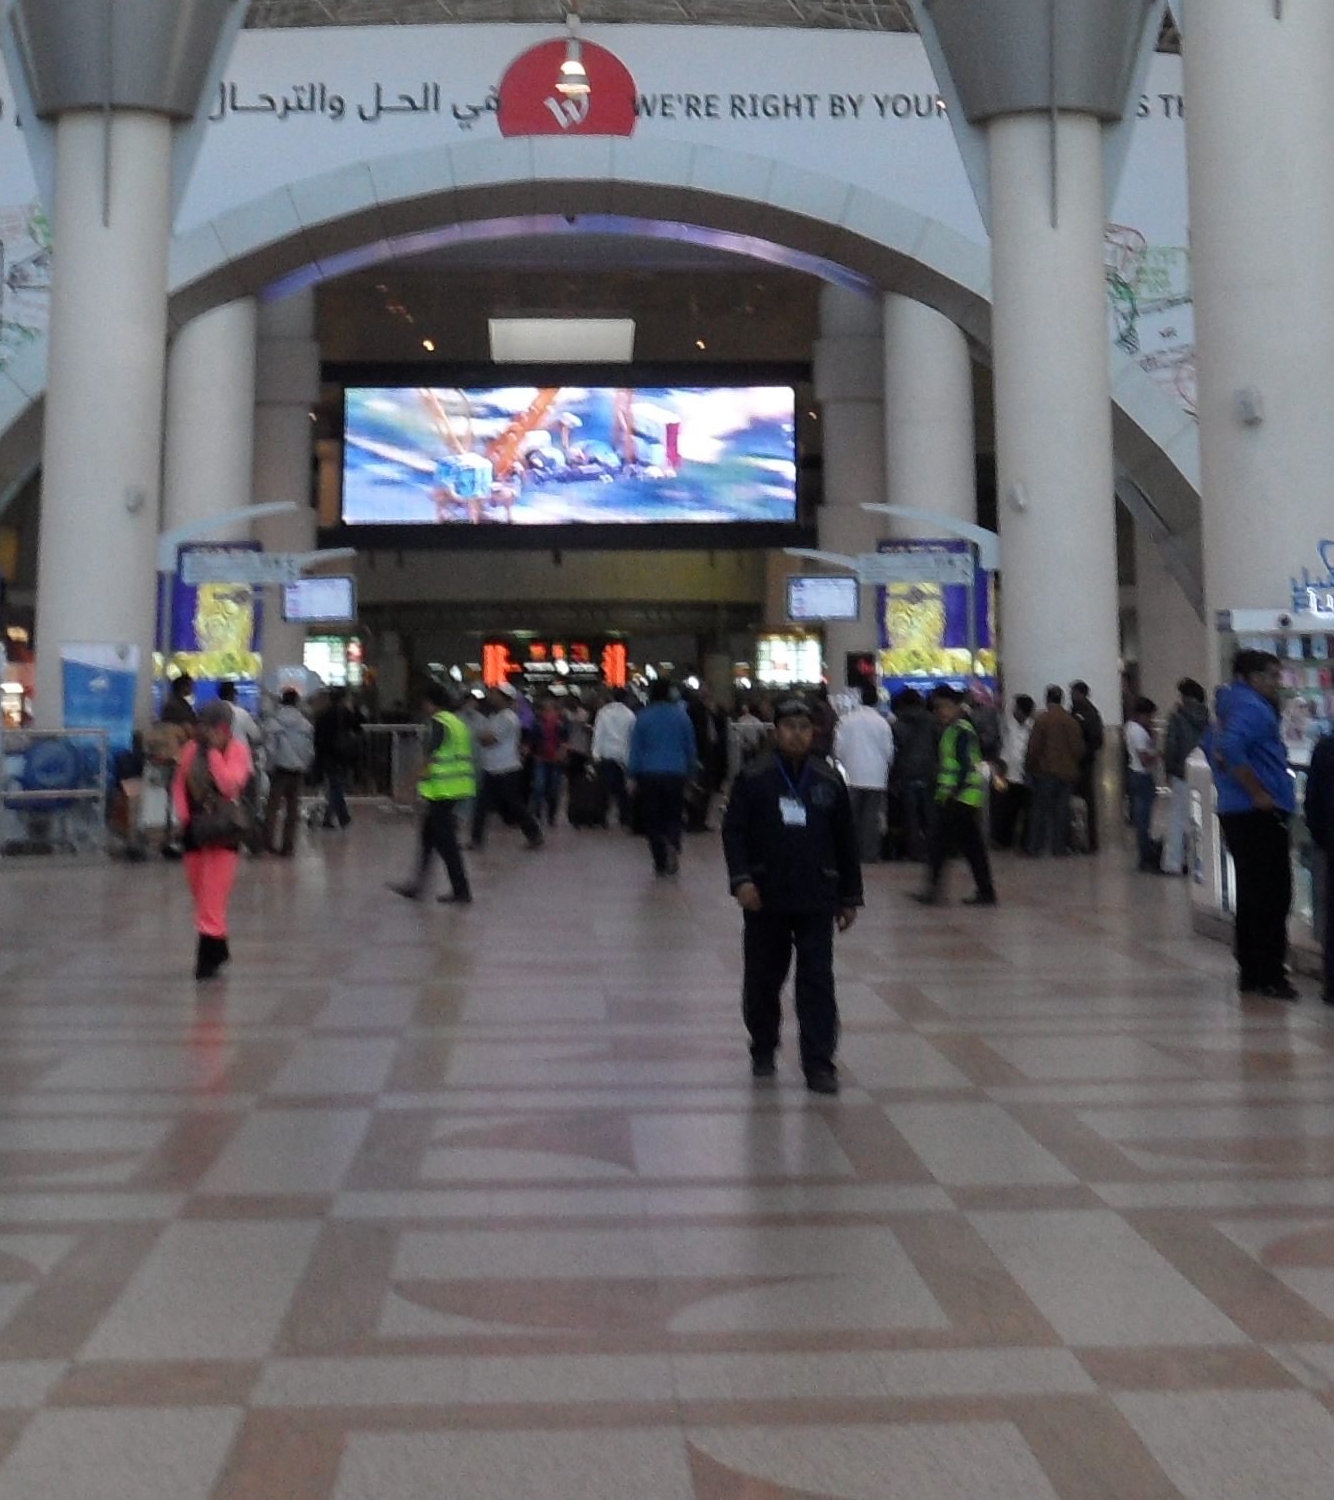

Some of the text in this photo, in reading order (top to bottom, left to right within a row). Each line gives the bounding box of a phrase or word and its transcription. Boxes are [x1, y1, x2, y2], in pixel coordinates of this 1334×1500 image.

[208, 81, 346, 122] والترحال
[356, 81, 441, 122] الحل
[634, 93, 720, 119] WE'RE
[728, 93, 821, 119] RIGHT
[828, 93, 866, 119] BY
